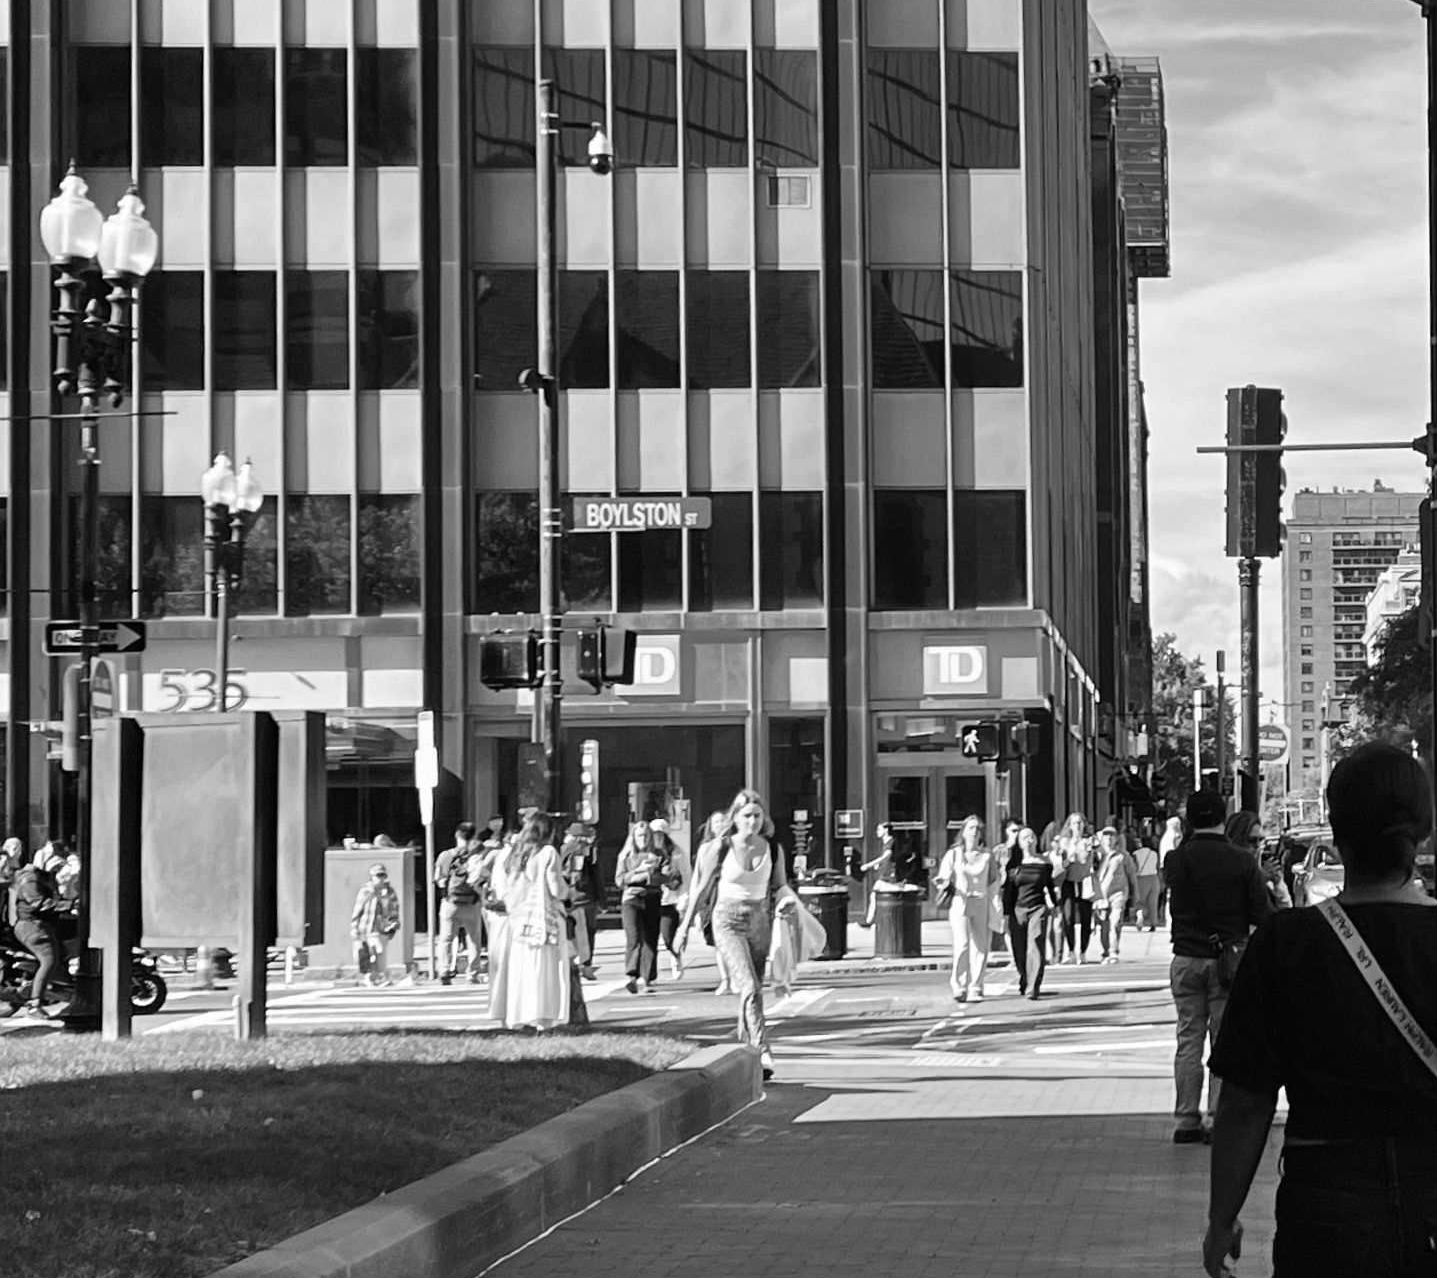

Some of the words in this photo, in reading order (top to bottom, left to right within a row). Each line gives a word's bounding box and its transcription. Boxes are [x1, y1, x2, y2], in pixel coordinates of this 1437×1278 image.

[586, 503, 681, 526] BOYLSTON
[684, 513, 698, 525] ST
[928, 646, 982, 683] TD
[160, 668, 248, 713] 535
[1375, 978, 1406, 1023] LAUREN
